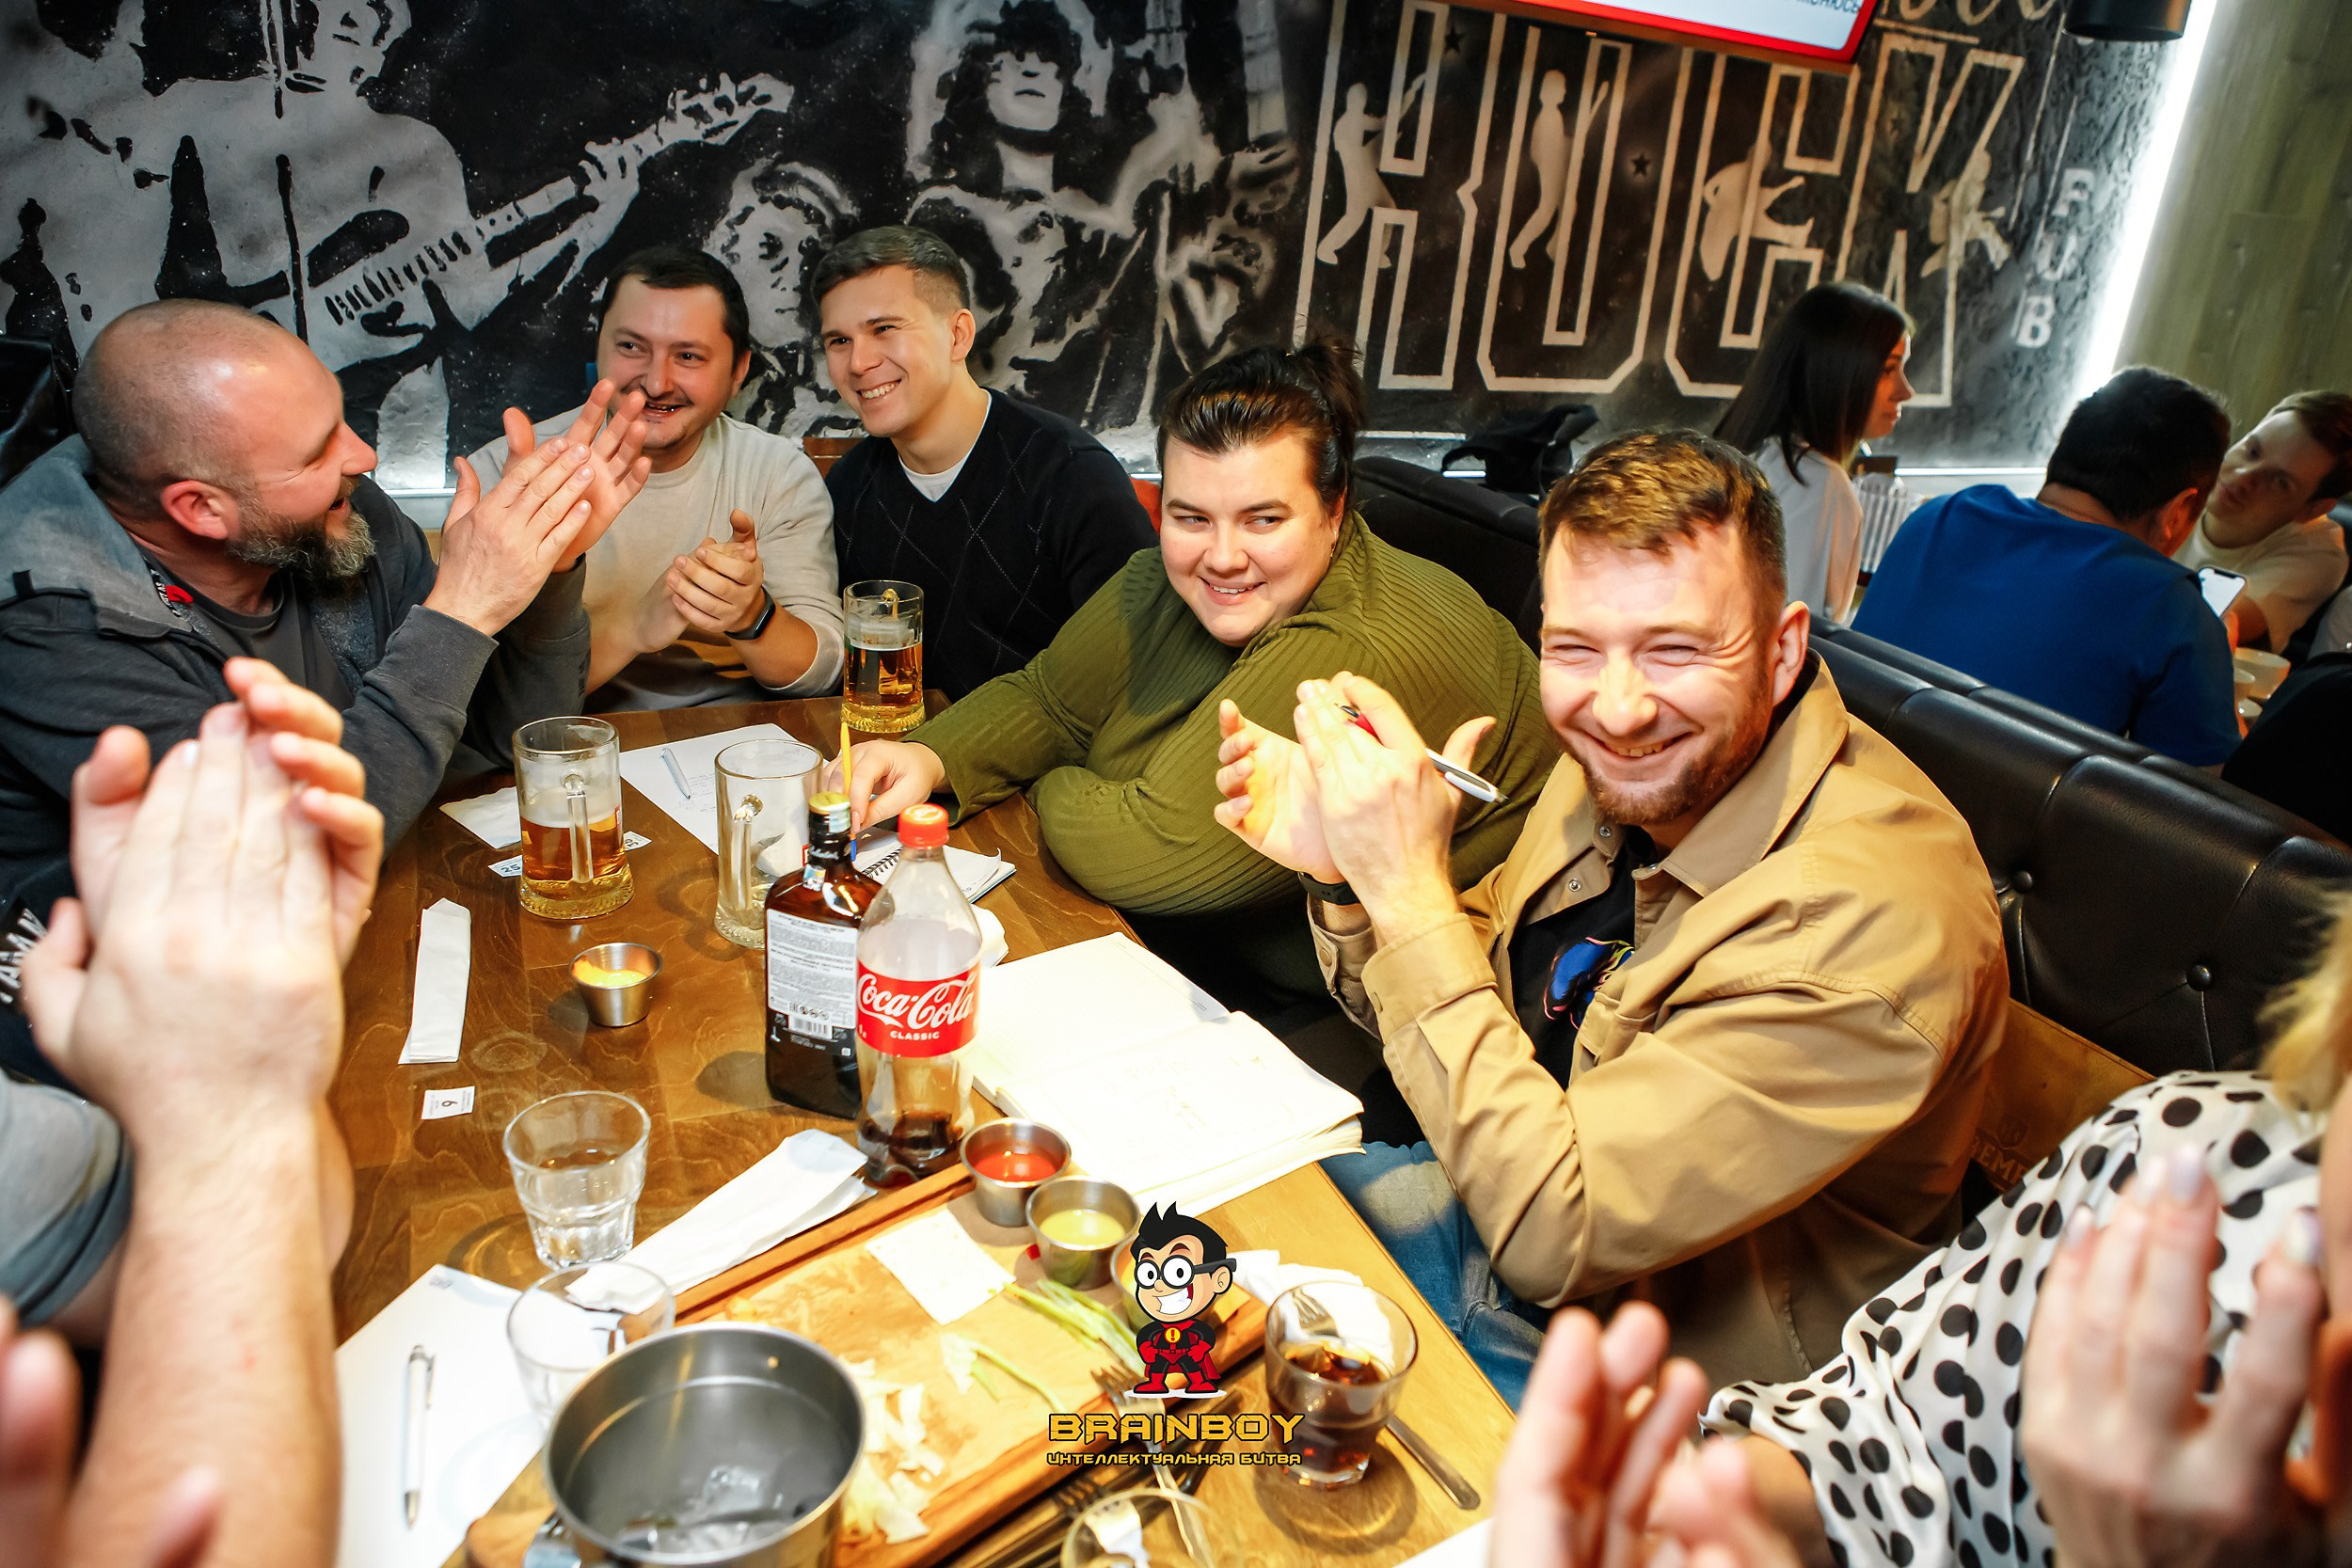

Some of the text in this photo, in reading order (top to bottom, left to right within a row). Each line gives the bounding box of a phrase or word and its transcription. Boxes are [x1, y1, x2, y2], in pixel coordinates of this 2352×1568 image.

[501, 863, 521, 873] 25
[857, 972, 977, 1030] Coca-Cola
[889, 1030, 941, 1041] CLASSIC
